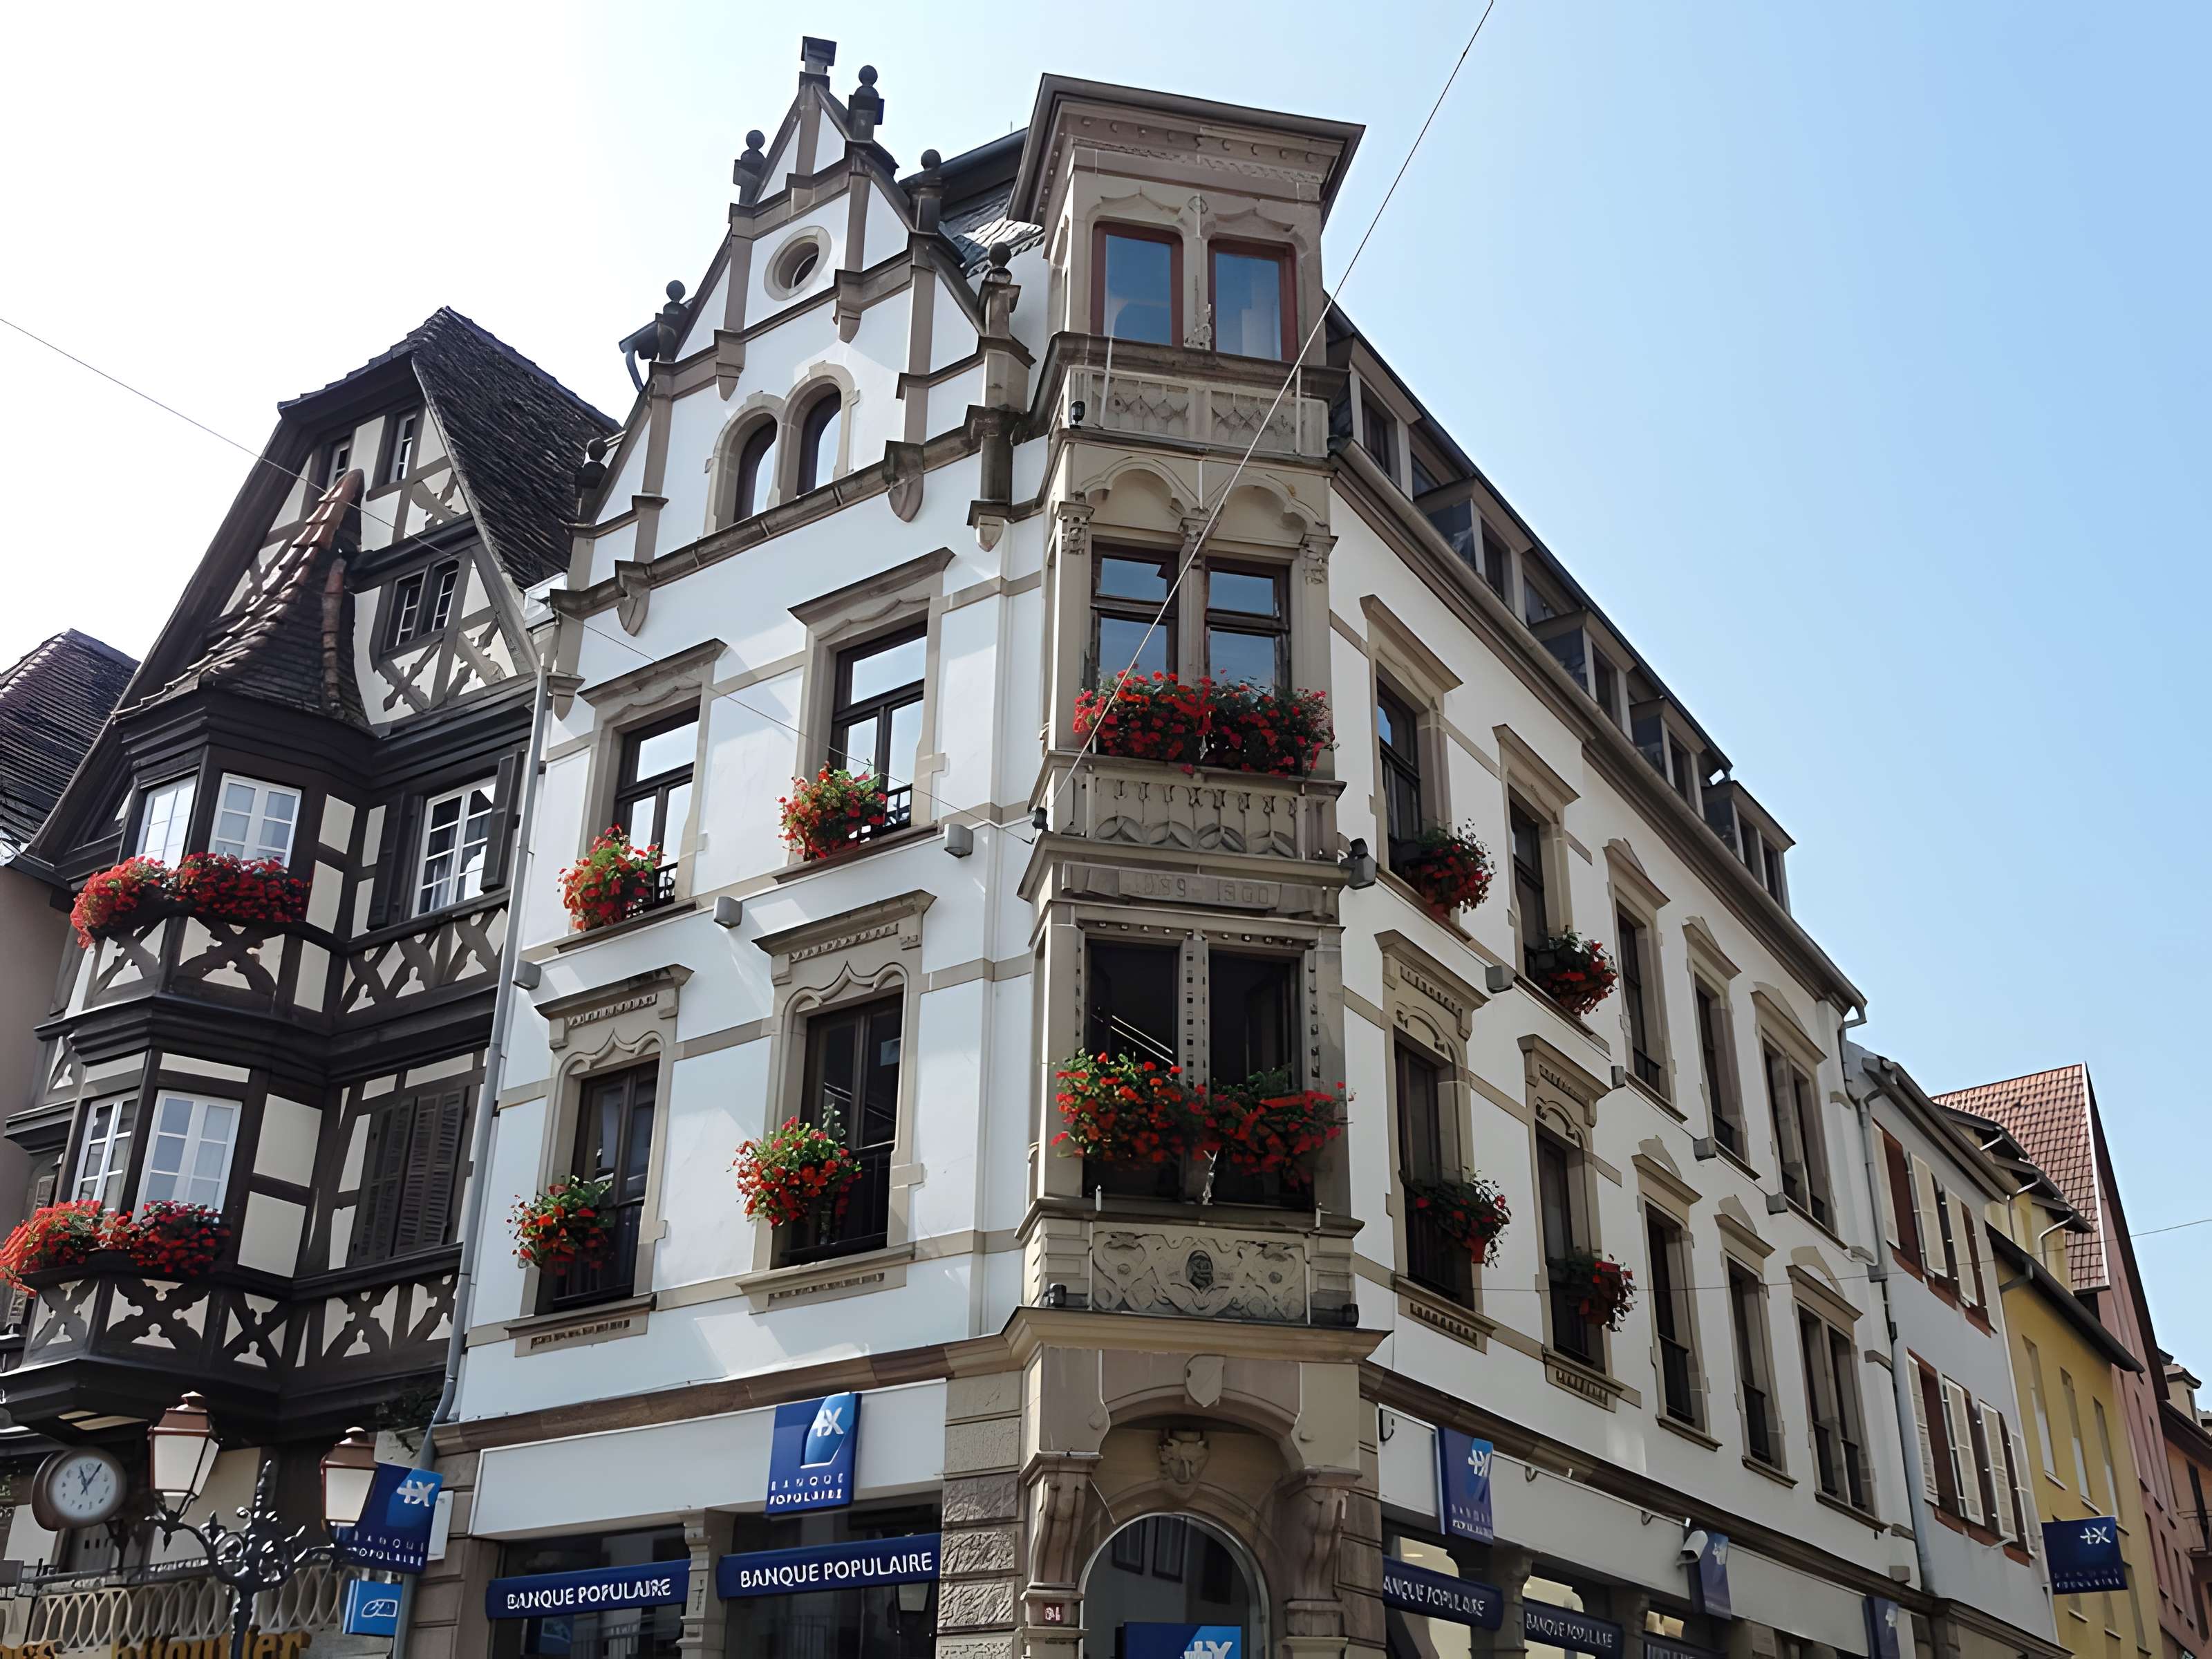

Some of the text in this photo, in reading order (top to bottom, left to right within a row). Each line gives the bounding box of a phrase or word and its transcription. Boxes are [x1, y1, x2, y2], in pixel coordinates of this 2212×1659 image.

[740, 1551, 932, 1588] BANQUE POPULAIRE
[507, 1578, 671, 1609] BANQUE POPULAIRE
[1383, 1575, 1424, 1602] ANQUE
